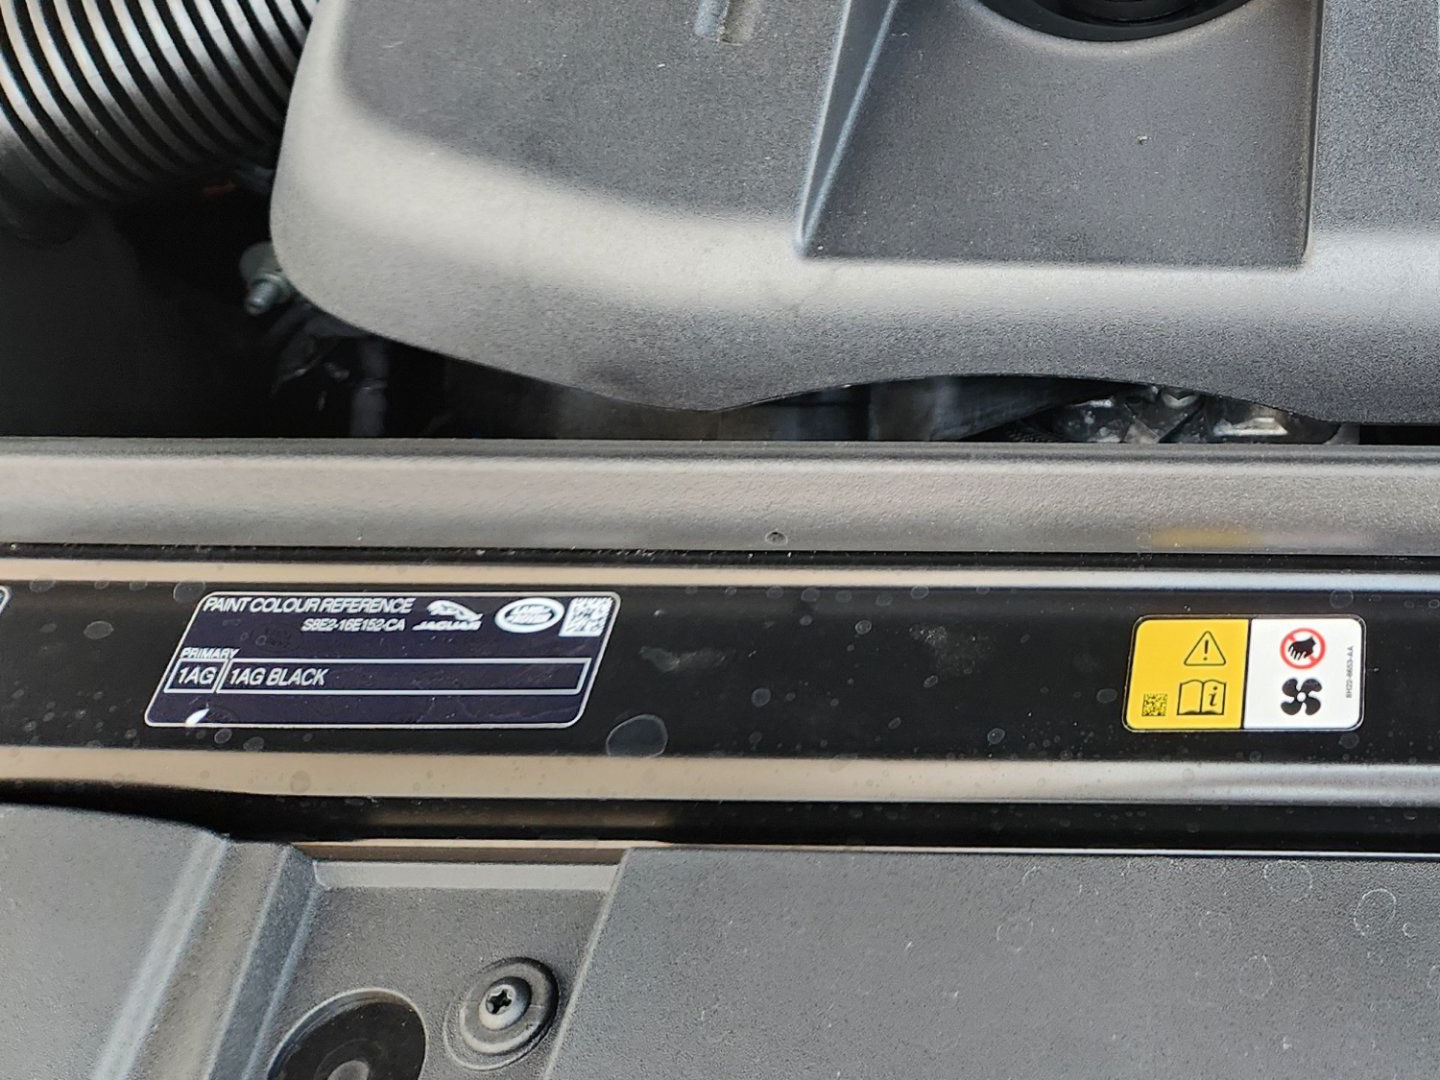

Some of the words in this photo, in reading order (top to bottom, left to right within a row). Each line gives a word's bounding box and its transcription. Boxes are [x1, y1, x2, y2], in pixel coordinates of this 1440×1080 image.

[203, 597, 251, 613] PAINT
[250, 597, 322, 613] COLOUR
[319, 597, 416, 614] REFERENCE
[180, 647, 241, 659] PRIMARY
[178, 667, 217, 684] 1AG
[229, 668, 266, 685] 1AG
[266, 668, 329, 686] BLACK
